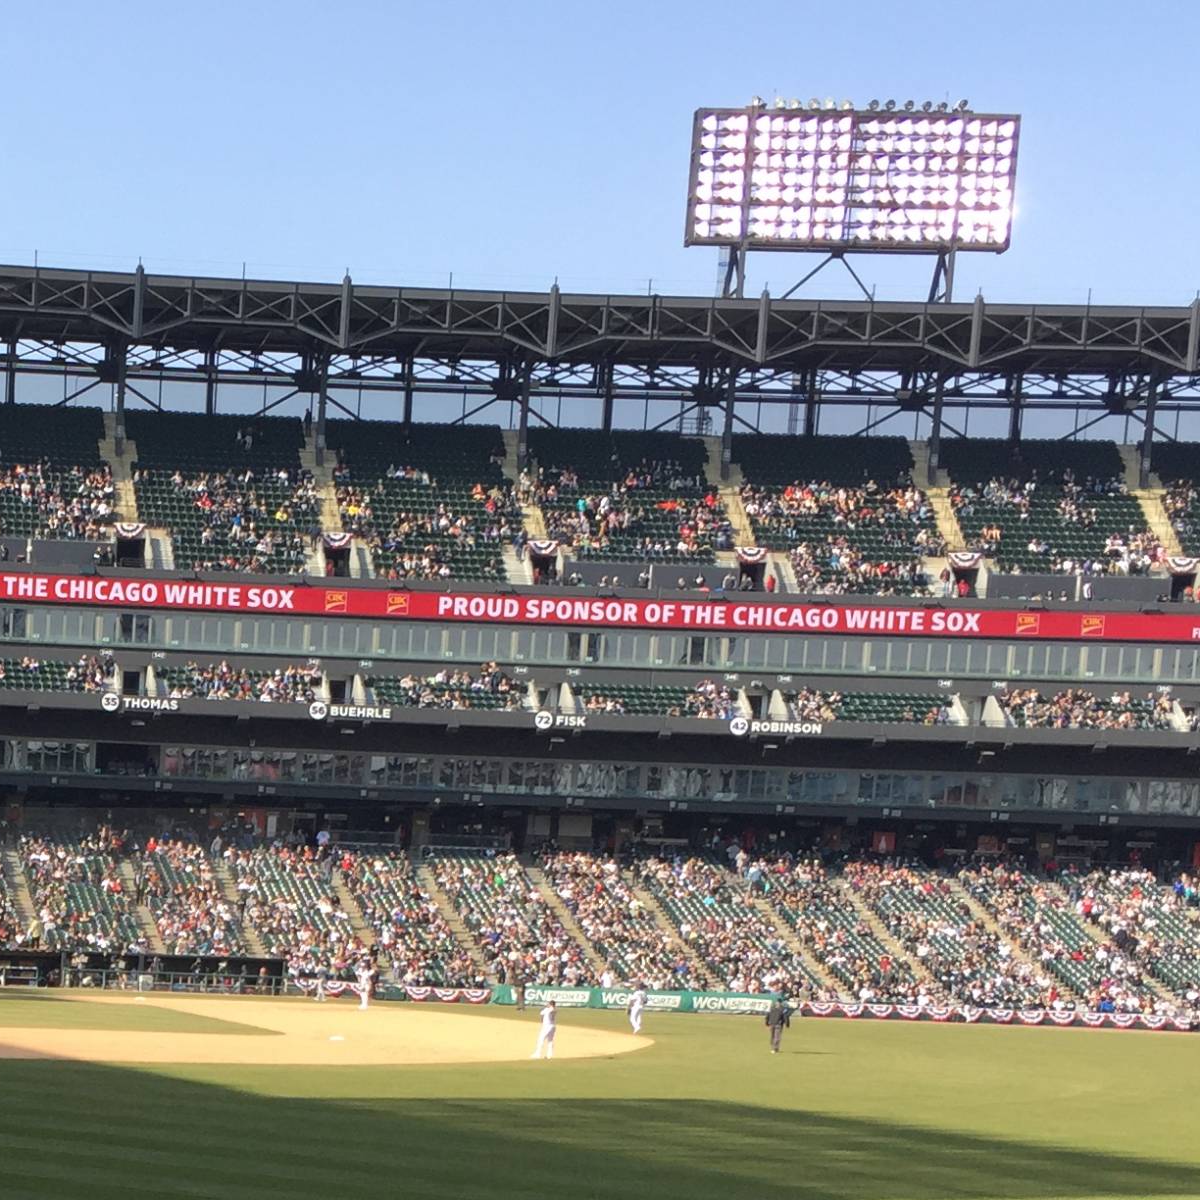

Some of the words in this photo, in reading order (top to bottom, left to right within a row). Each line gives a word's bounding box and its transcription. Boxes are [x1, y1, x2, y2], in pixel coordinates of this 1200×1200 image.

[3, 576, 48, 598] THE
[54, 579, 158, 603] CHICAGO
[164, 584, 241, 607] WHITE
[247, 588, 294, 609] SOX
[438, 596, 519, 618] PROUD
[526, 600, 638, 622] SPONSOR
[645, 603, 675, 623] OF
[682, 605, 726, 625] THE
[733, 606, 838, 628] CHICAGO
[845, 609, 924, 630] WHITE
[931, 612, 981, 632] SOX
[104, 697, 117, 707] 35
[123, 698, 178, 710] THOMAS
[311, 705, 325, 716] 56
[330, 706, 391, 719] BUEHRLE
[536, 714, 552, 726] 72
[556, 716, 586, 727] FISK
[731, 720, 747, 732] 42
[751, 721, 822, 734] ROBINSON
[550, 990, 589, 1000] SPORTS
[692, 996, 729, 1009] WGN
[731, 1000, 771, 1012] SPORTS
